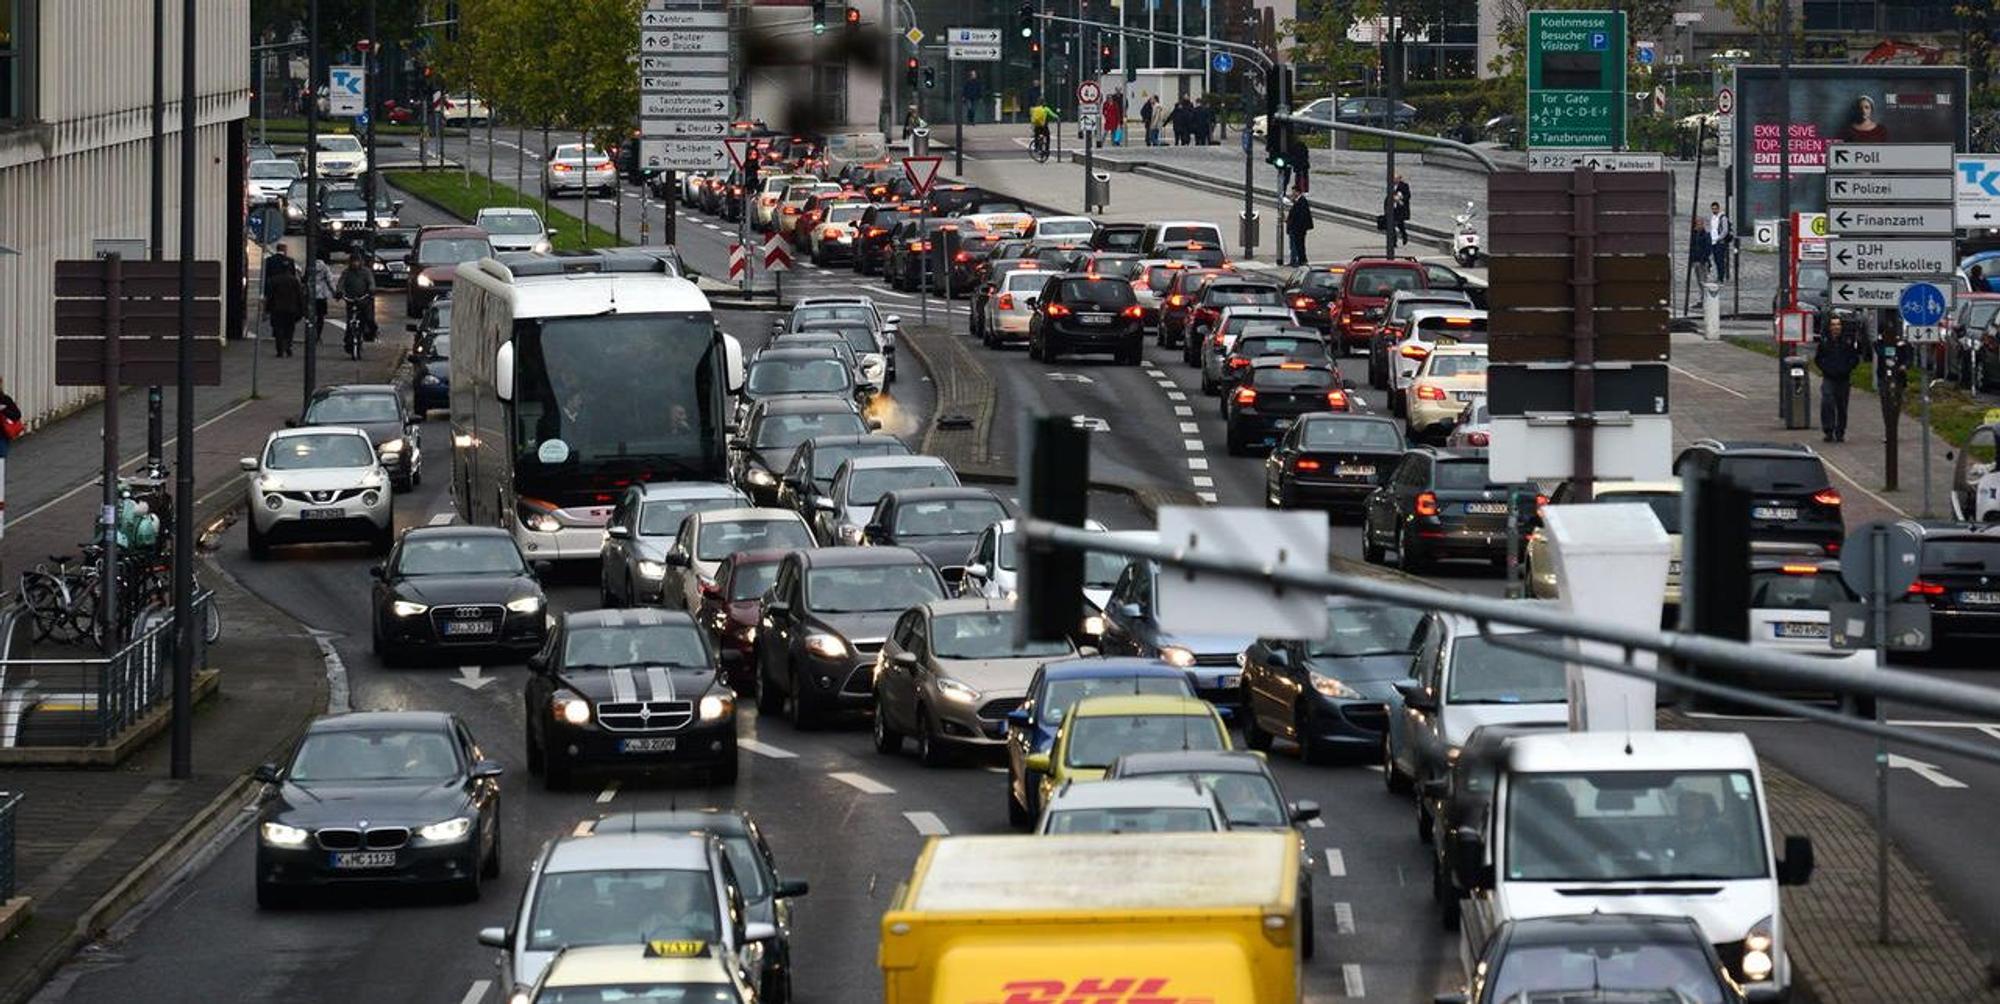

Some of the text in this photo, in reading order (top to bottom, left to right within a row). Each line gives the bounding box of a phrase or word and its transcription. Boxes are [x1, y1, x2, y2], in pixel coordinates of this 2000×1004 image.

[659, 15, 694, 23] Zentrum
[1541, 17, 1606, 28] Koelnmesse
[673, 33, 704, 42] Deutzer
[1541, 30, 1587, 40] Besucher
[1594, 33, 1605, 48] P
[1541, 41, 1580, 51] Visitors
[332, 71, 362, 94] TK
[660, 97, 711, 105] Tanzbrunnen
[1542, 94, 1590, 104] Tor Gate
[649, 106, 711, 114] Rheinterrassen
[1542, 133, 1607, 143] Tanzbrunnen
[676, 144, 711, 152] Seilbahn
[1755, 139, 1822, 151] TOP-ERIEN
[1544, 156, 1566, 168] P22
[1855, 152, 1880, 163] Poll
[1958, 162, 2000, 196] TK
[1853, 183, 1892, 194] Polizei
[1857, 214, 1924, 226] Finanzamt
[1758, 228, 1771, 243] C
[1857, 244, 1883, 255] DJH
[1857, 258, 1942, 273] Berufskolleg
[1858, 288, 1894, 299] Deutzer
[1000, 978, 1181, 1004] DHL
